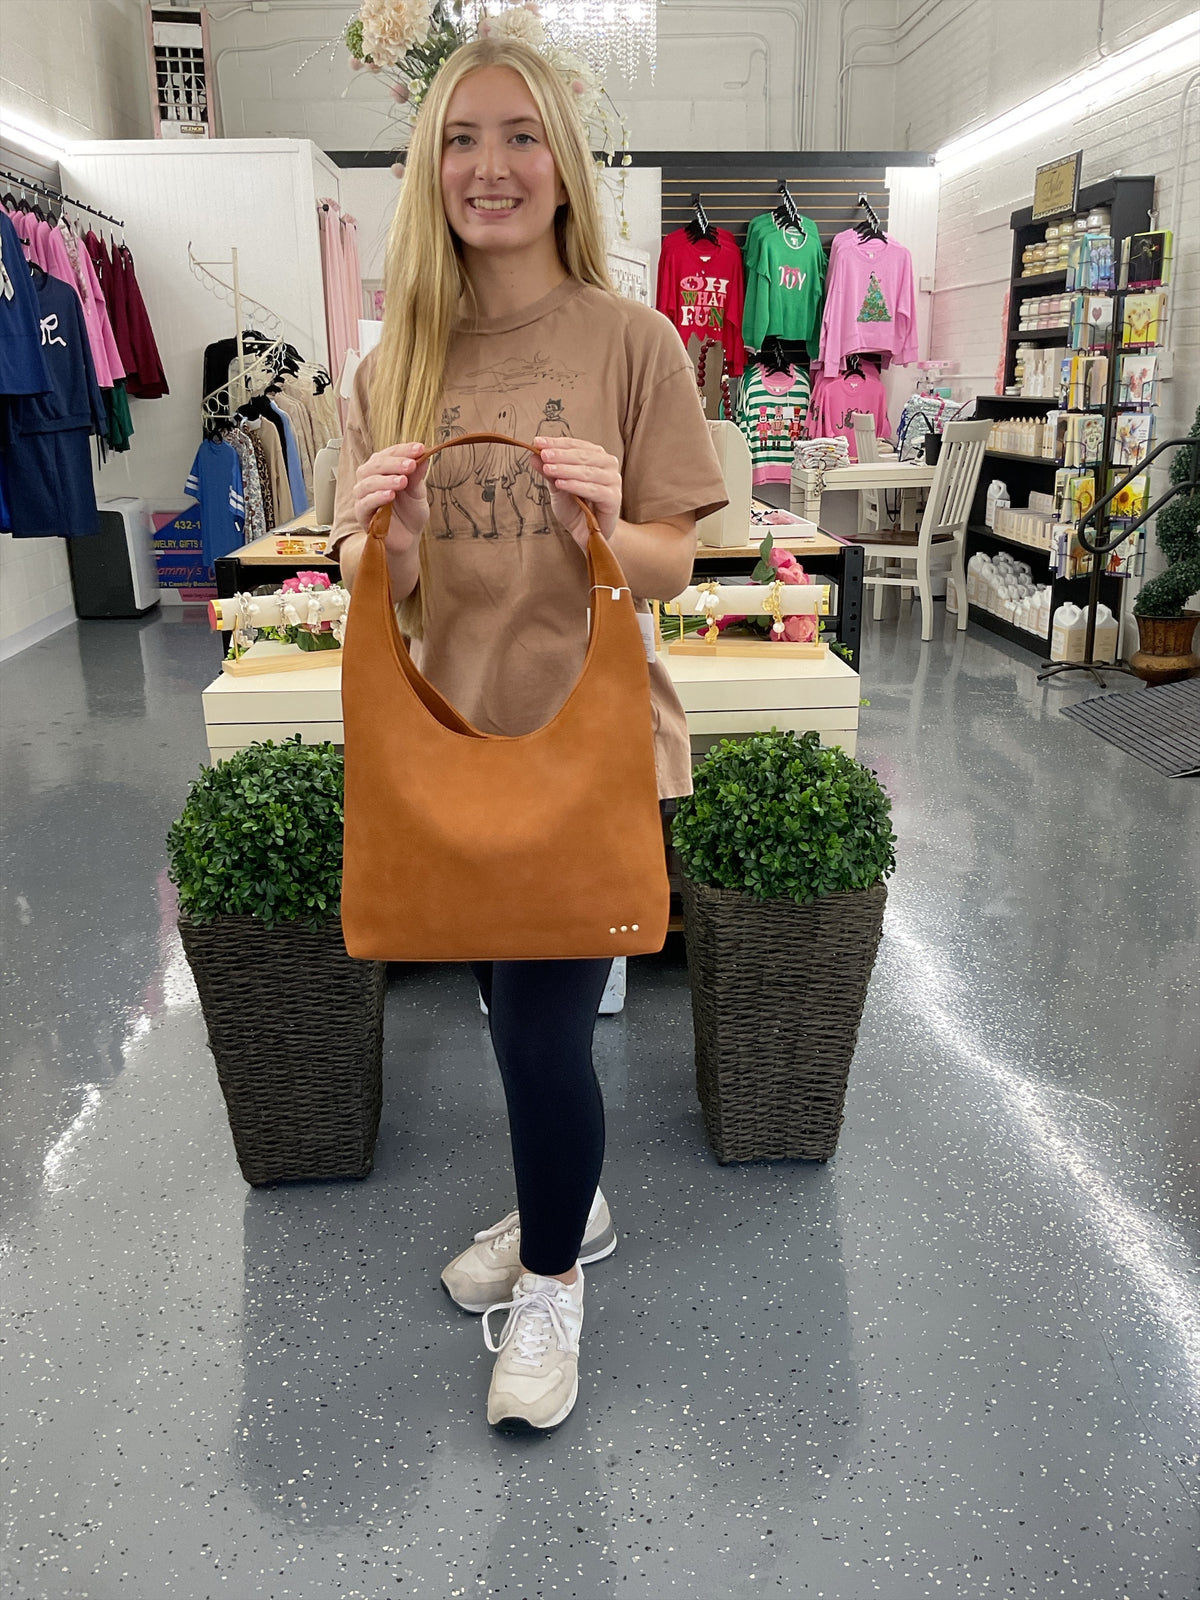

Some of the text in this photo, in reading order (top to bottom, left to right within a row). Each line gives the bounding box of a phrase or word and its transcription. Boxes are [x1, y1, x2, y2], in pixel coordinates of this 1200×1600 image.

[680, 275, 729, 294] OH
[778, 265, 807, 291] JOY
[680, 291, 727, 307] WHAT
[680, 305, 725, 328] FUN
[152, 540, 178, 549] WELRY,
[179, 540, 199, 548] GIFTS
[157, 562, 203, 580] ammy's
